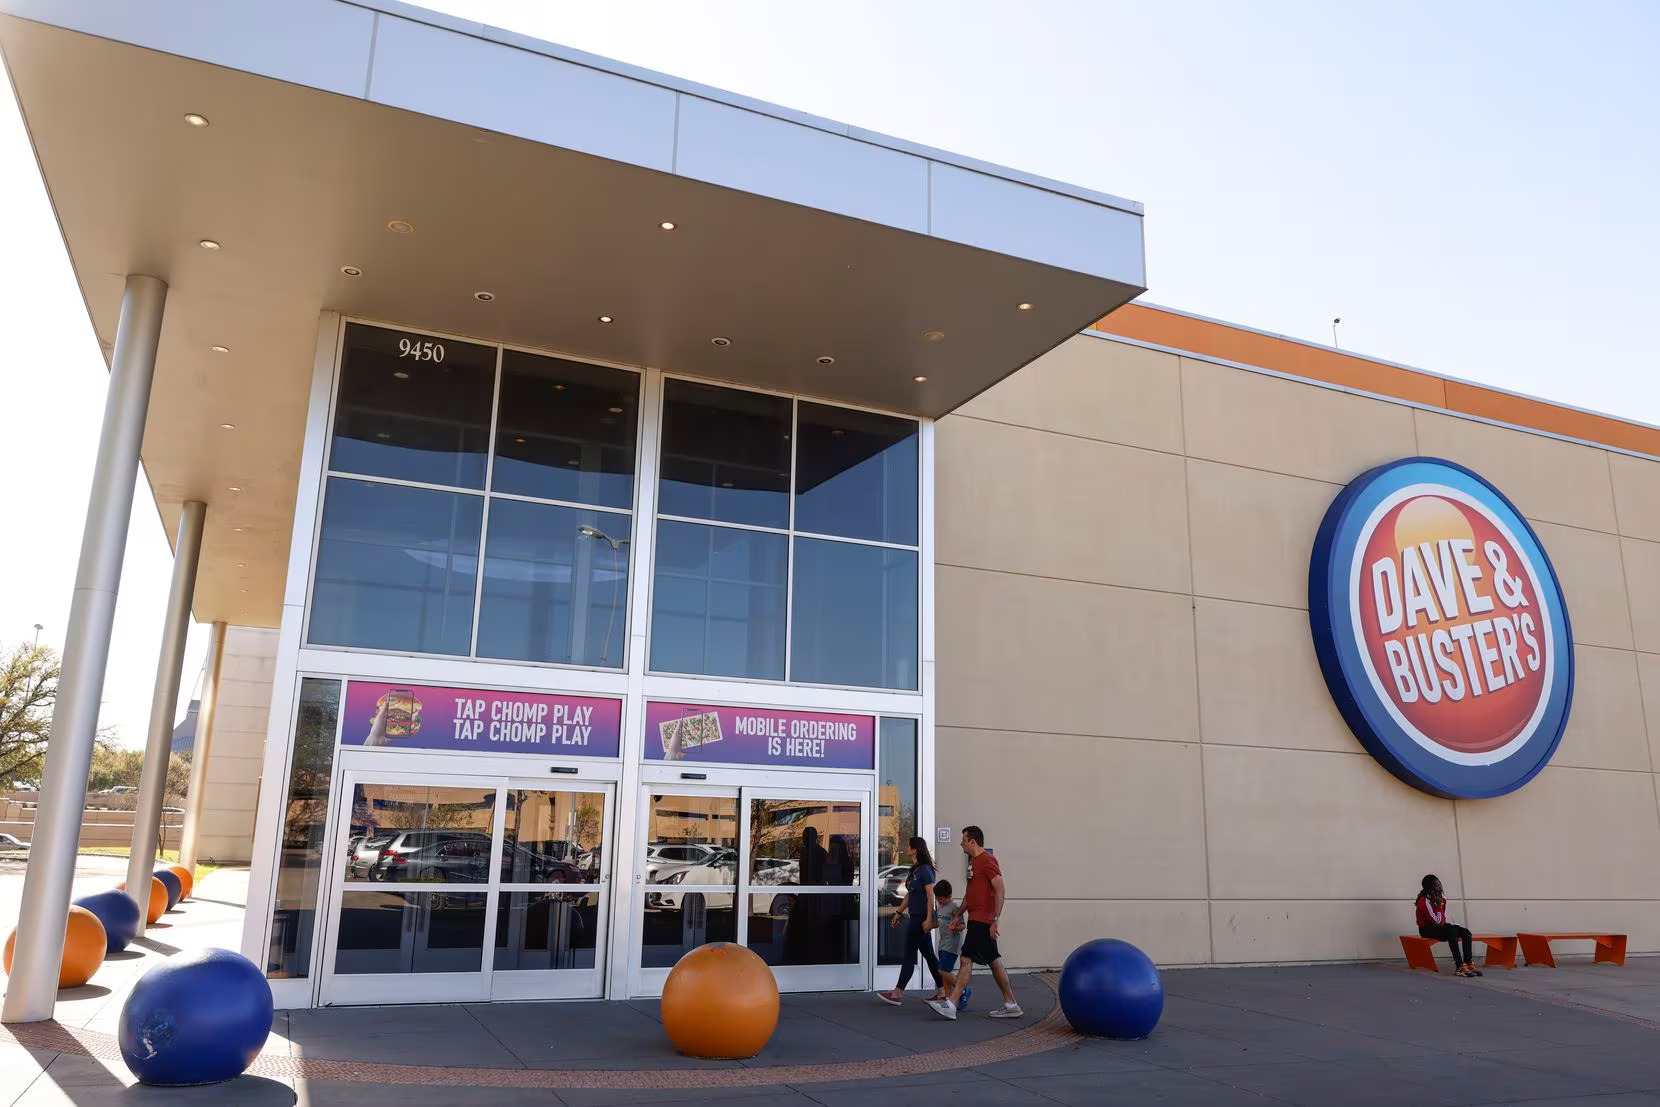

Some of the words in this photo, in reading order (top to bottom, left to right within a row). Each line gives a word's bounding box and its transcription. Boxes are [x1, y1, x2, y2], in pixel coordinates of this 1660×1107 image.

[399, 338, 445, 363] 9450
[1371, 539, 1495, 634] DAVE
[1483, 540, 1530, 609] &
[1384, 612, 1541, 704] BUSTER'S
[455, 698, 486, 719] TAP
[491, 700, 548, 723] CHOMP
[553, 704, 593, 726] PLAY
[453, 719, 484, 740] TAP
[489, 721, 547, 744] CHOMP
[551, 724, 592, 746] PLAY
[735, 716, 787, 737] MOBILE
[790, 720, 857, 741] ORDERING
[767, 736, 782, 756] IS
[786, 738, 825, 758] HERE!
